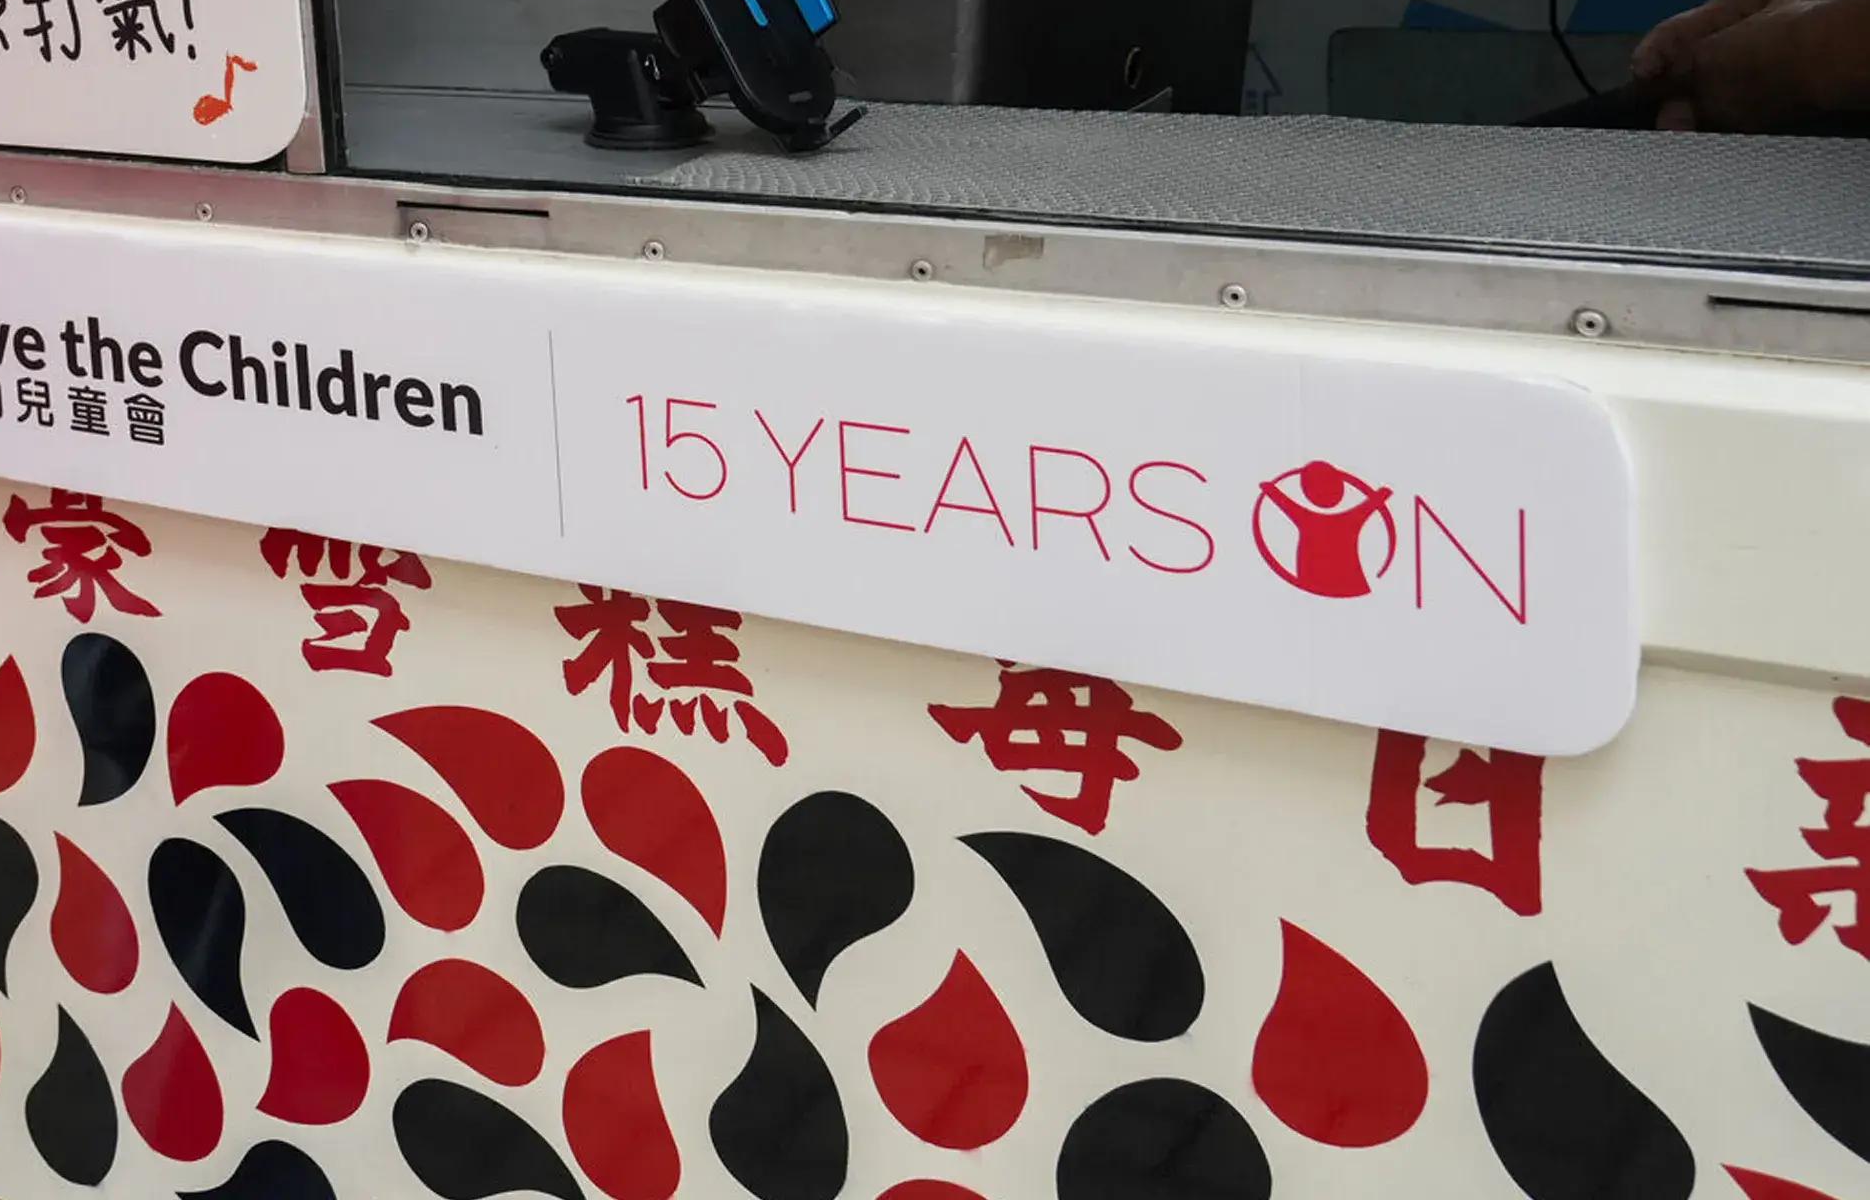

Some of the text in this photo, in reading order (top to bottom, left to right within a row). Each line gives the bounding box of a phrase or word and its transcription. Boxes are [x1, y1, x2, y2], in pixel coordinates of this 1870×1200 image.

[60, 314, 164, 389] the
[178, 328, 484, 437] Children
[626, 394, 728, 500] 15
[754, 408, 1215, 574] YEARS
